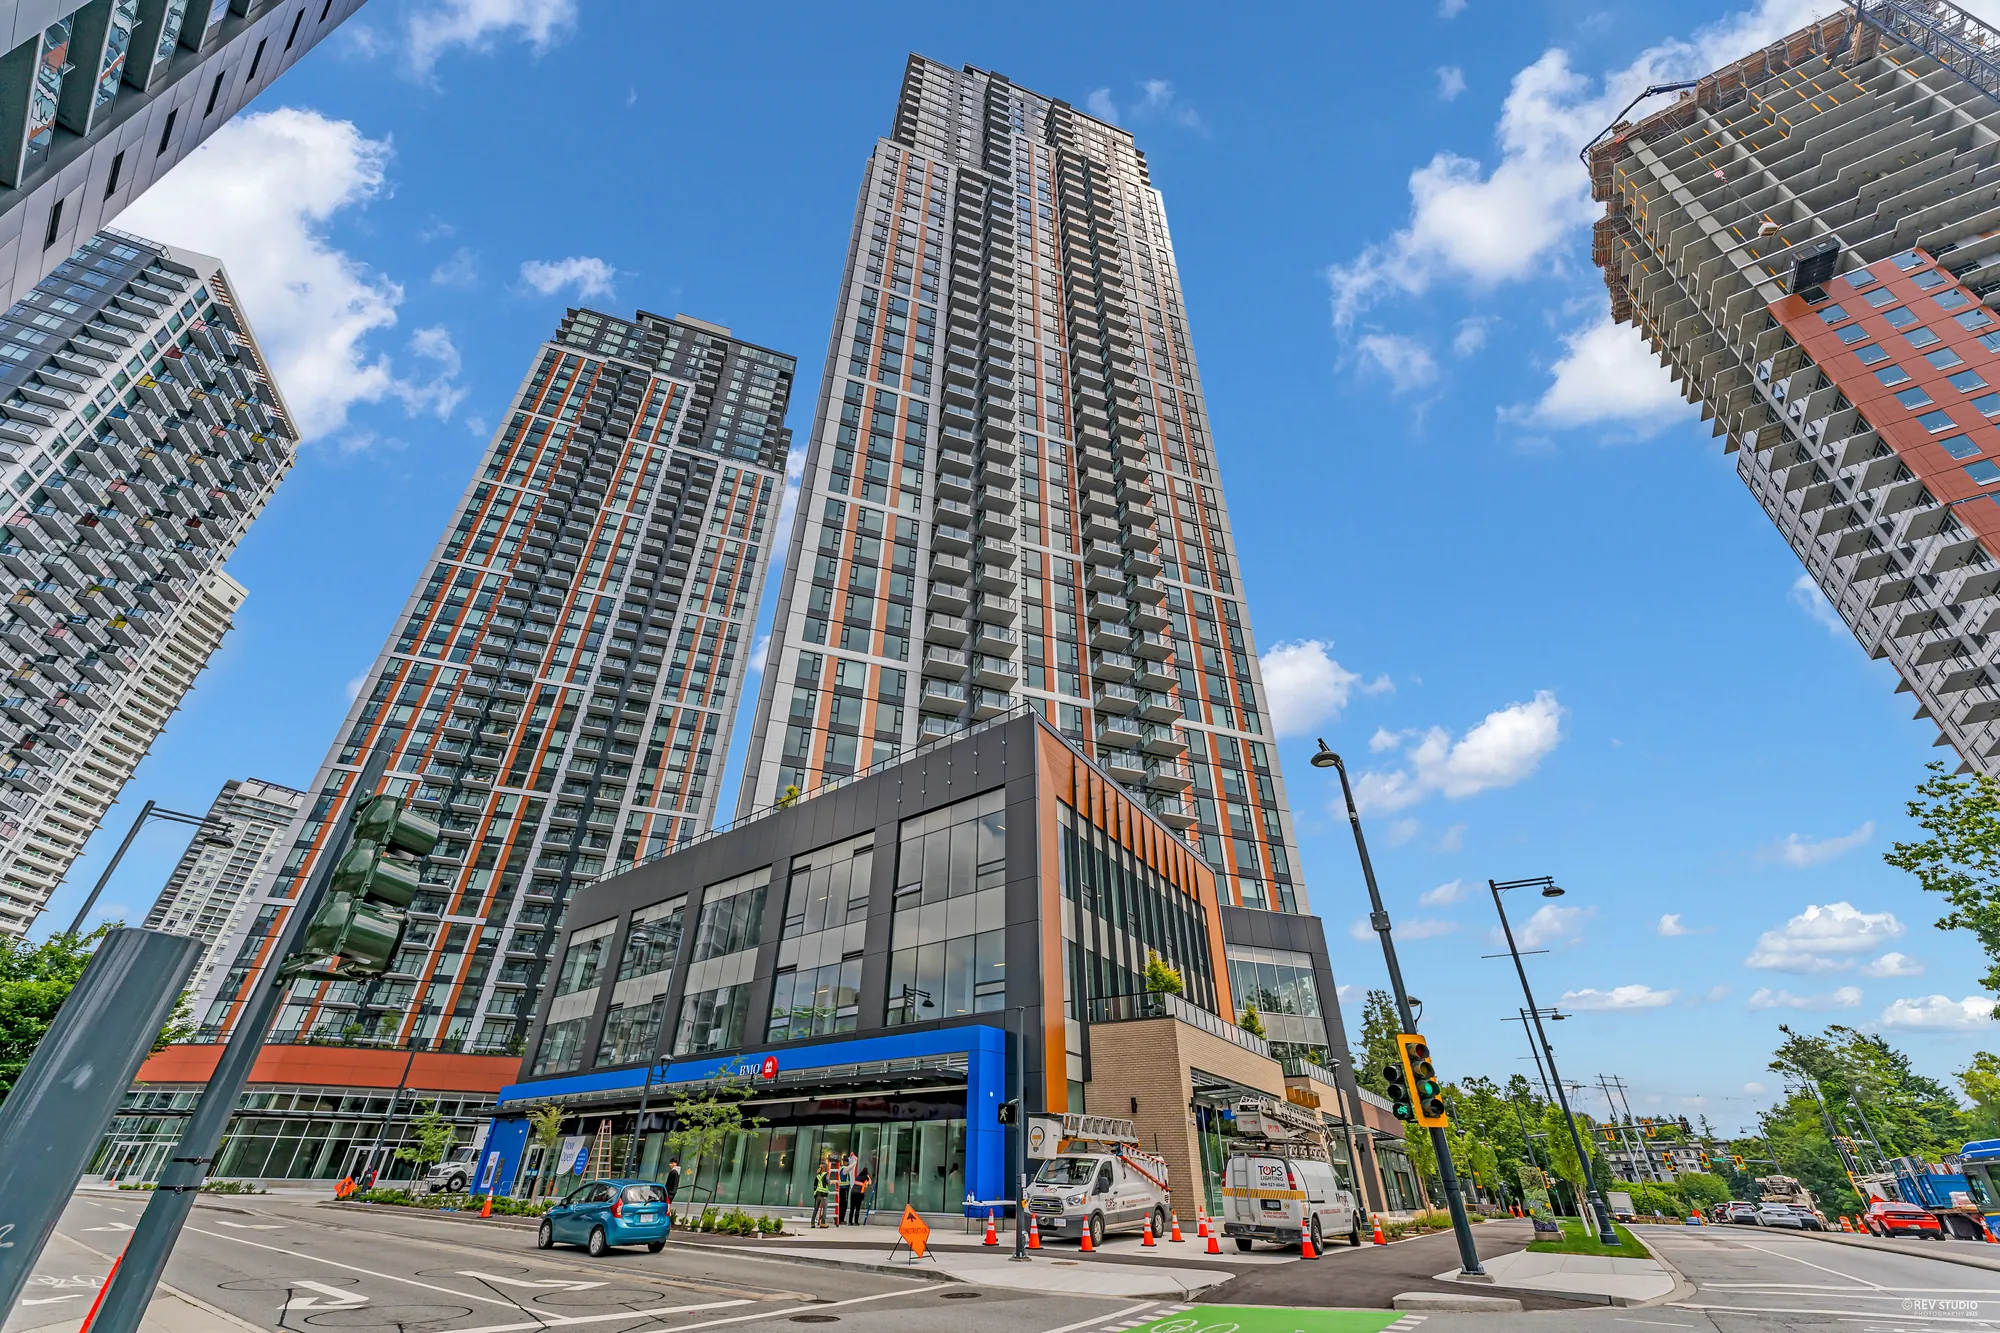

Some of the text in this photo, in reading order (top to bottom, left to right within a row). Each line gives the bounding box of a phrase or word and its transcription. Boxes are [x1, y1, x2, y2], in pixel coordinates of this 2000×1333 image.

[740, 1063, 760, 1076] BMO
[565, 1140, 576, 1150] Now
[1258, 1166, 1283, 1176] TOPS
